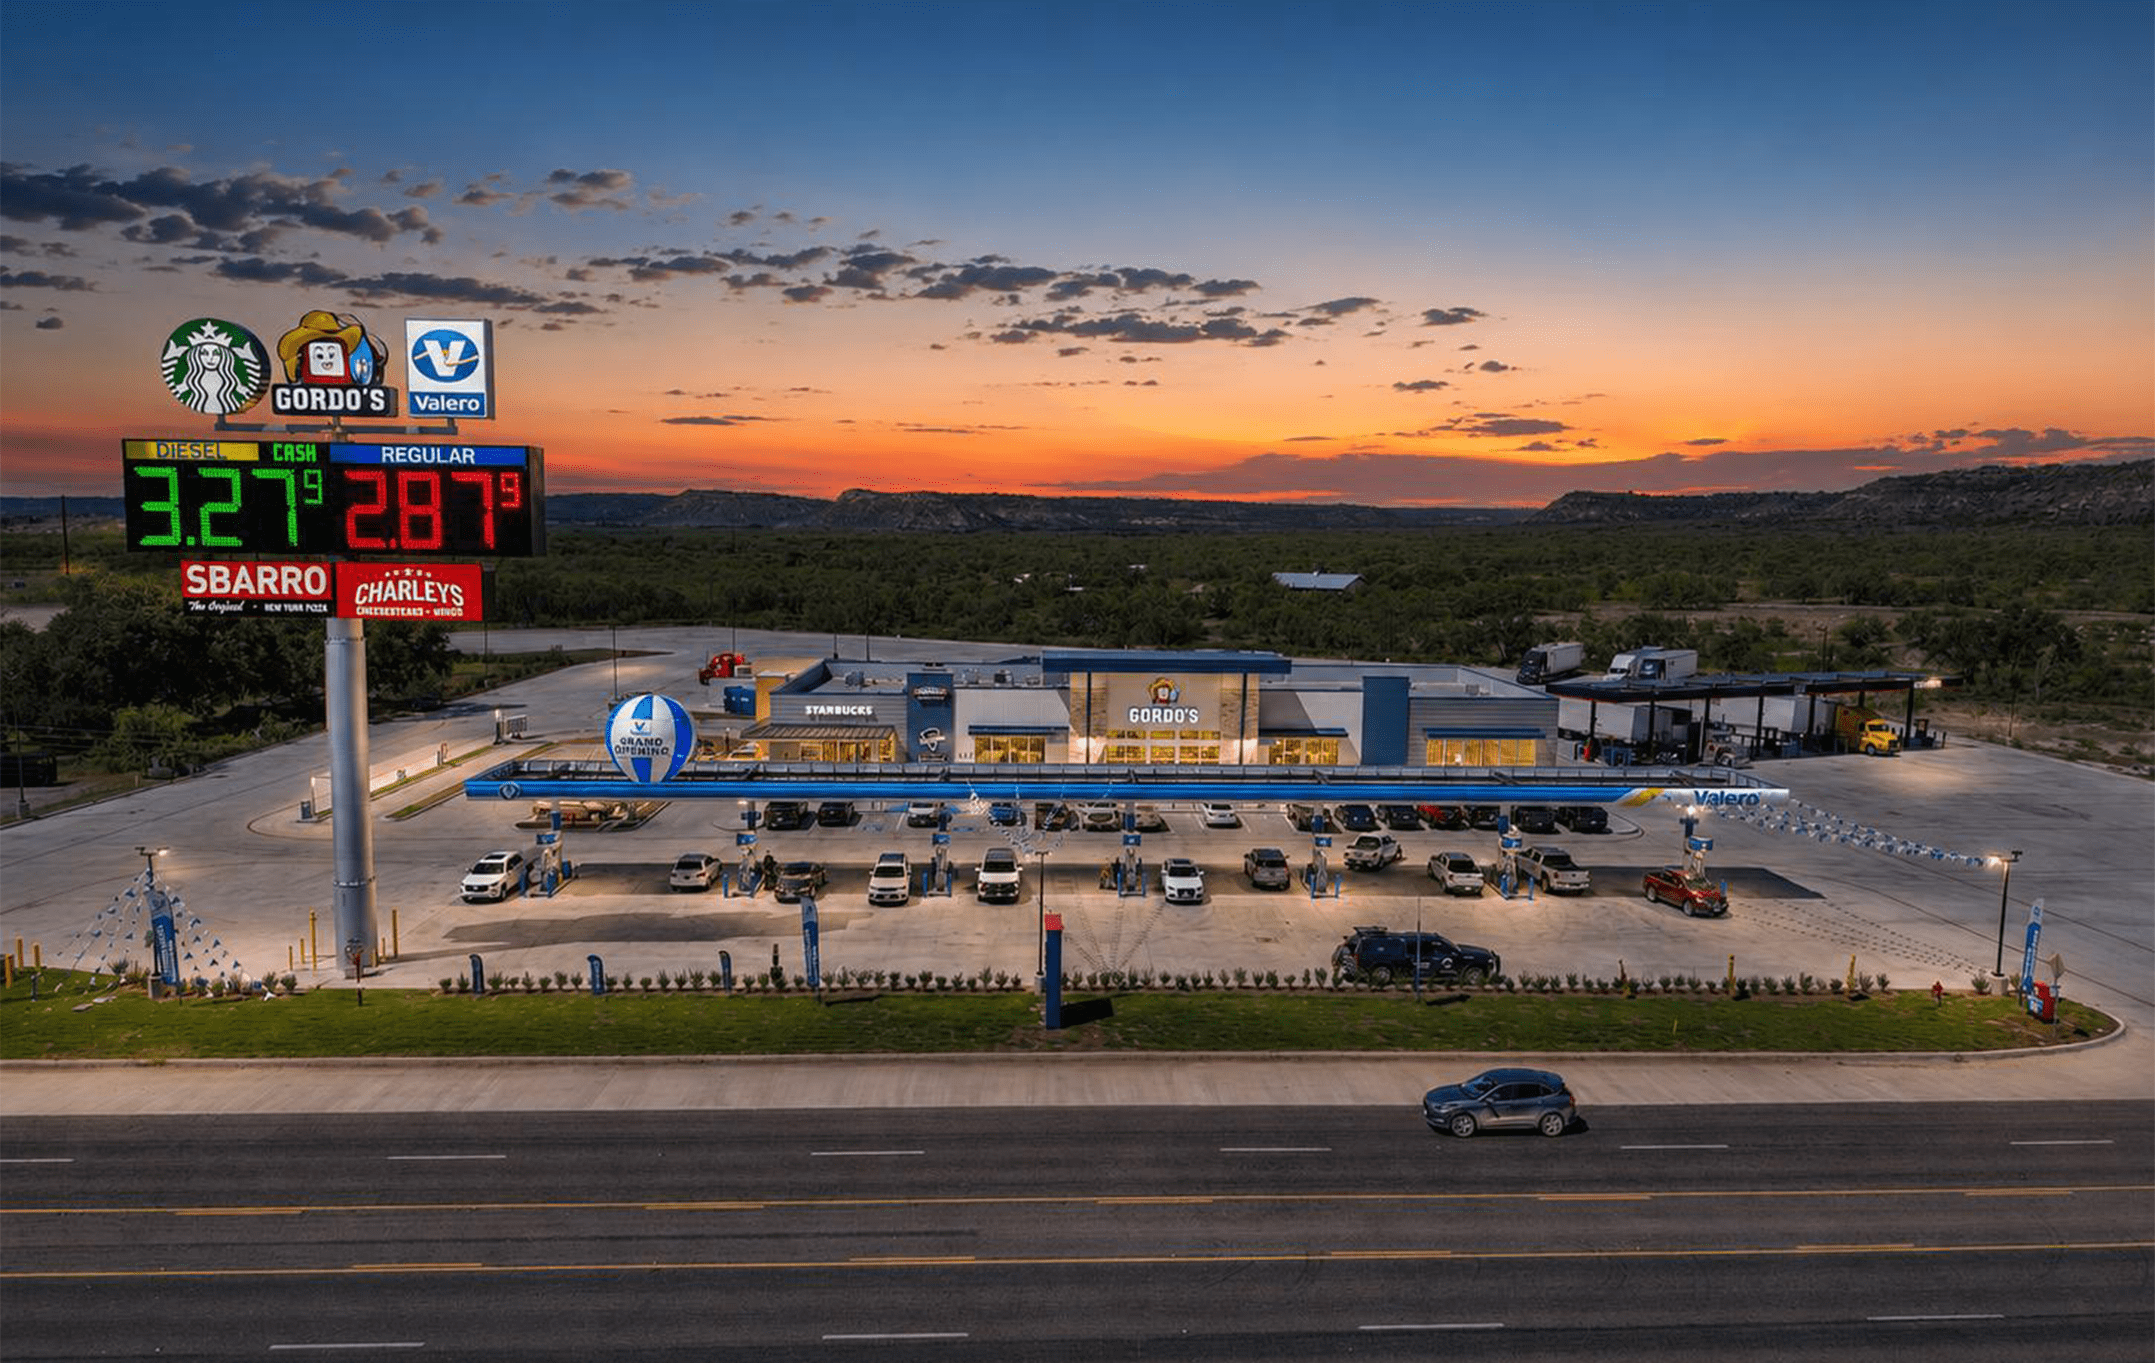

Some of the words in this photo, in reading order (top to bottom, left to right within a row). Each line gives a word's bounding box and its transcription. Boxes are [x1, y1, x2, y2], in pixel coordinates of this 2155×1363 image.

[275, 387, 386, 411] GORDO'S
[414, 394, 481, 412] Valero
[156, 440, 227, 460] DIESEL
[272, 442, 317, 463] CASH
[381, 446, 476, 465] REGULAR
[186, 563, 328, 596] SBARRO
[354, 579, 465, 607] CHARLEYS
[188, 600, 206, 612] The
[805, 704, 874, 716] STARBUCKS
[1128, 707, 1200, 724] GORDO'S
[1693, 789, 1761, 806] Valero
